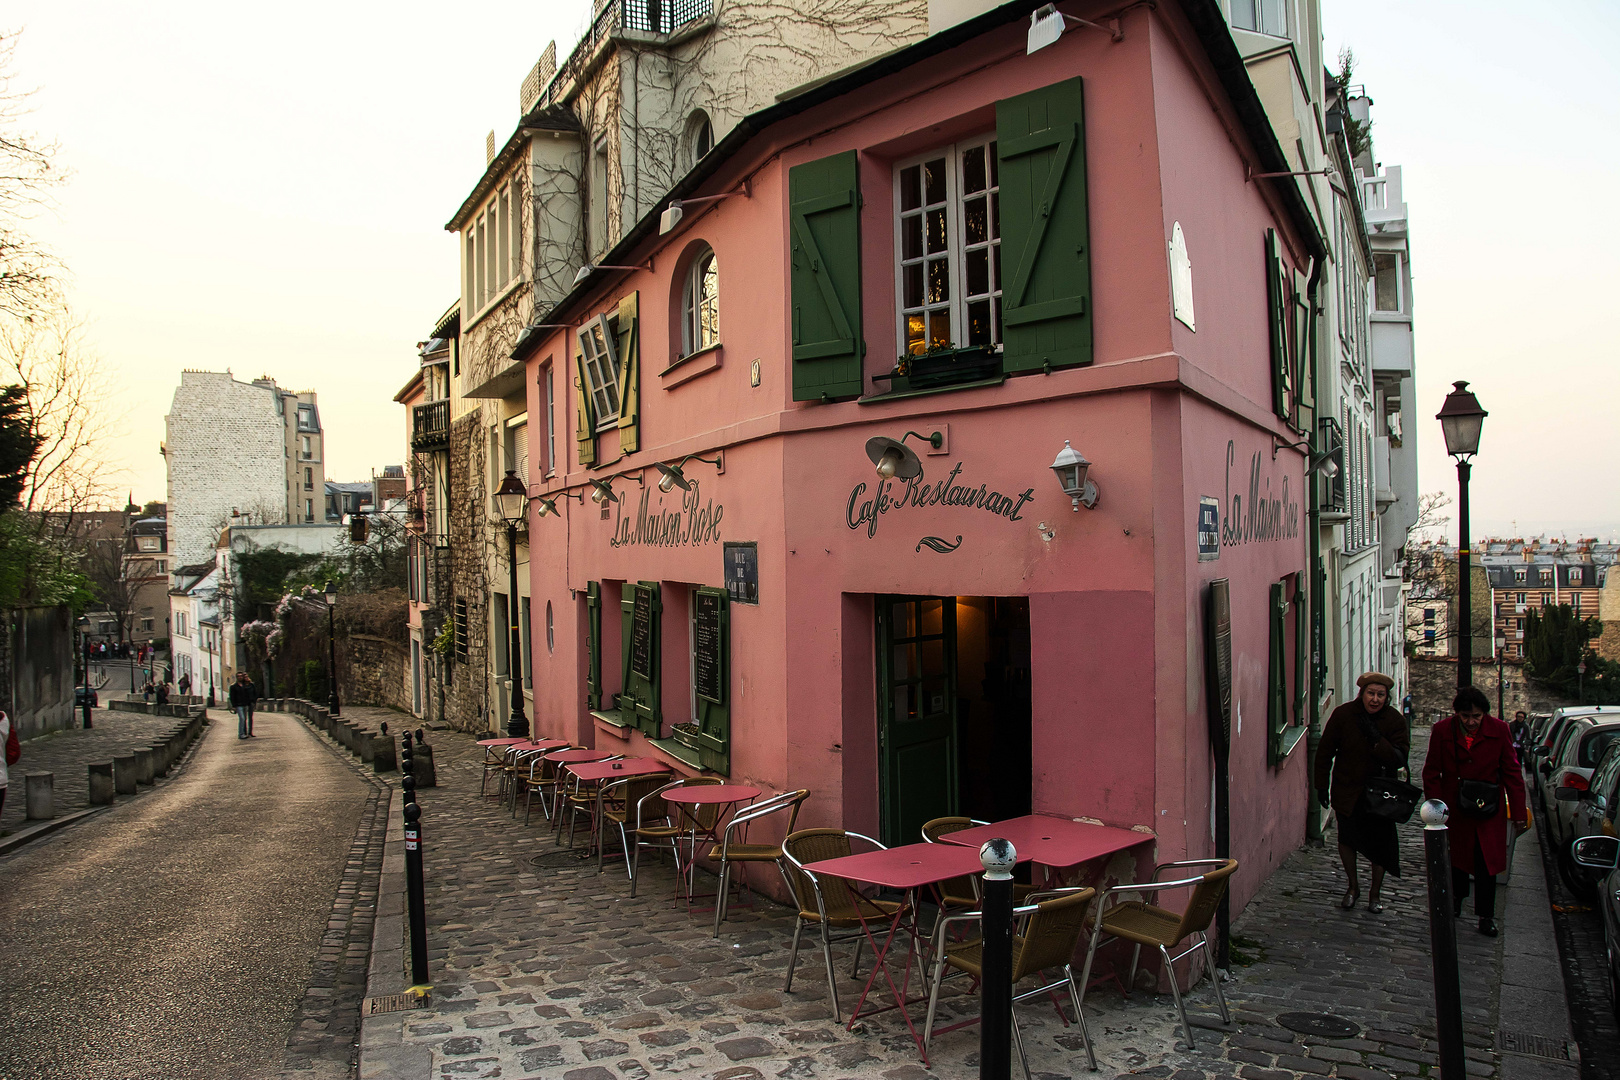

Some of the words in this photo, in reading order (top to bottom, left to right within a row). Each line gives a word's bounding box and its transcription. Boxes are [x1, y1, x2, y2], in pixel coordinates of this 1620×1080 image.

[610, 490, 630, 549] La
[630, 485, 682, 548] Maison
[682, 478, 724, 548] Rose
[893, 461, 1035, 522] Restaurant
[1222, 439, 1243, 547] La
